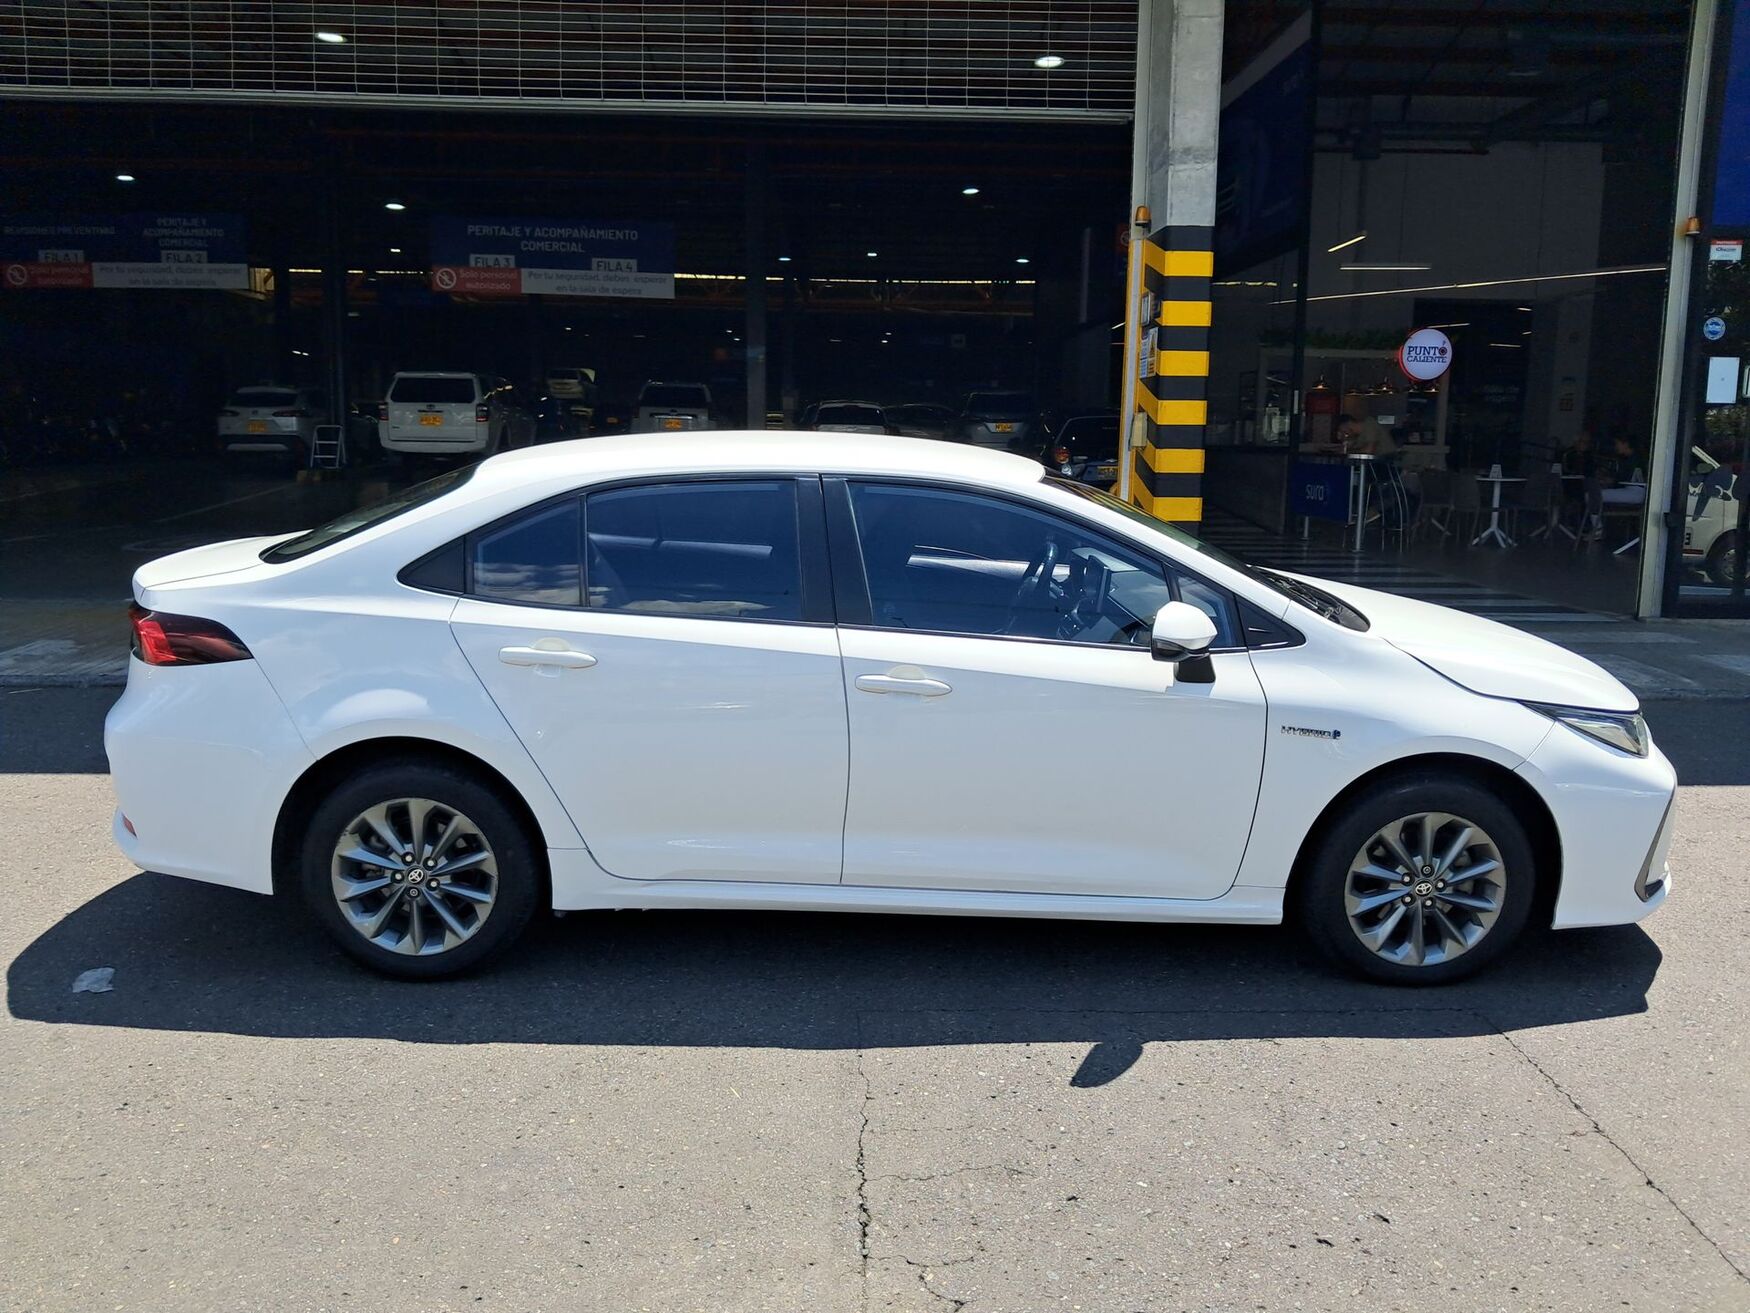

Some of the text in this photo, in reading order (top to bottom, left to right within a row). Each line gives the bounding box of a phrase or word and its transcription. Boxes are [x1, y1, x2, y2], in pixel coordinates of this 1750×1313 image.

[467, 225, 639, 241] PERITAJE Y ACOMPAÑAMIENTO
[520, 240, 586, 253] COMERCIAL
[166, 252, 203, 263] FILA 2
[474, 256, 511, 268] FILA 3
[596, 260, 633, 271] FILA 4
[1407, 345, 1448, 356] PUNTO
[1407, 355, 1448, 363] CALIENTE
